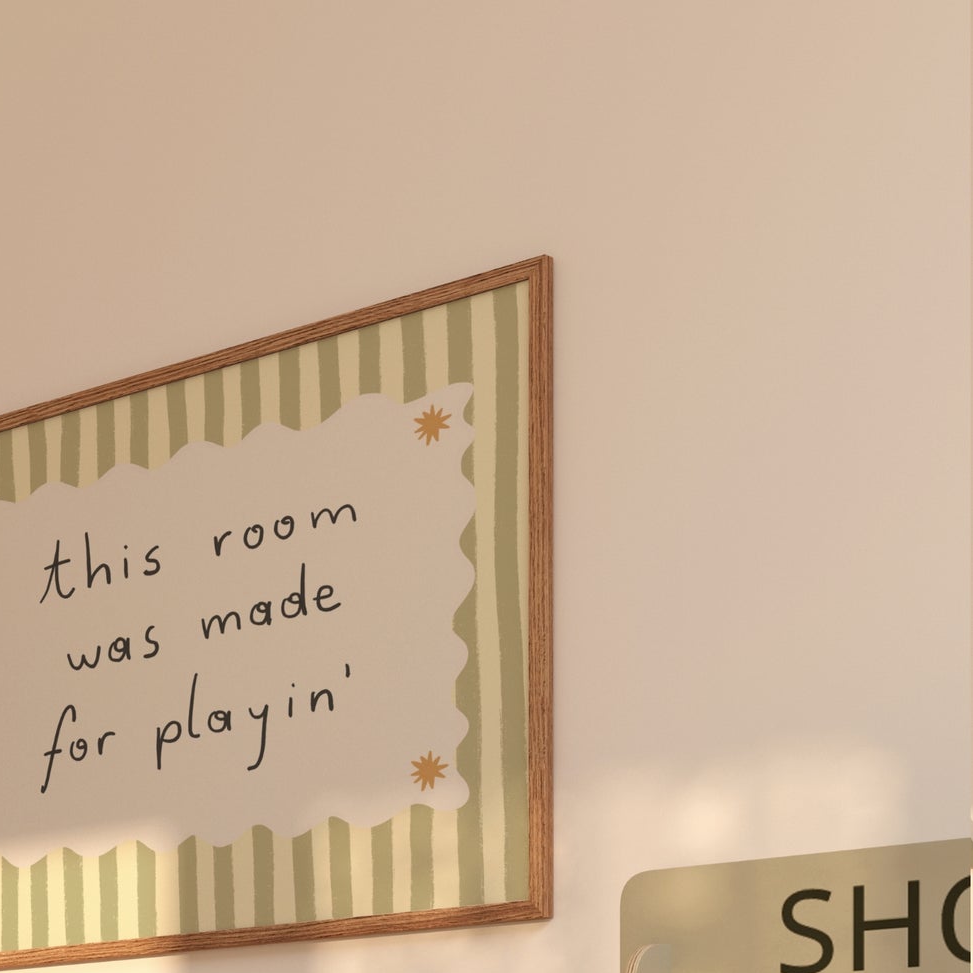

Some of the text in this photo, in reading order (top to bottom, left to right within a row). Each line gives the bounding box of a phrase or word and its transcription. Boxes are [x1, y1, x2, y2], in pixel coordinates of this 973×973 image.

[40, 503, 357, 604] this room
[67, 563, 342, 670] was made
[40, 664, 351, 794] for playin'
